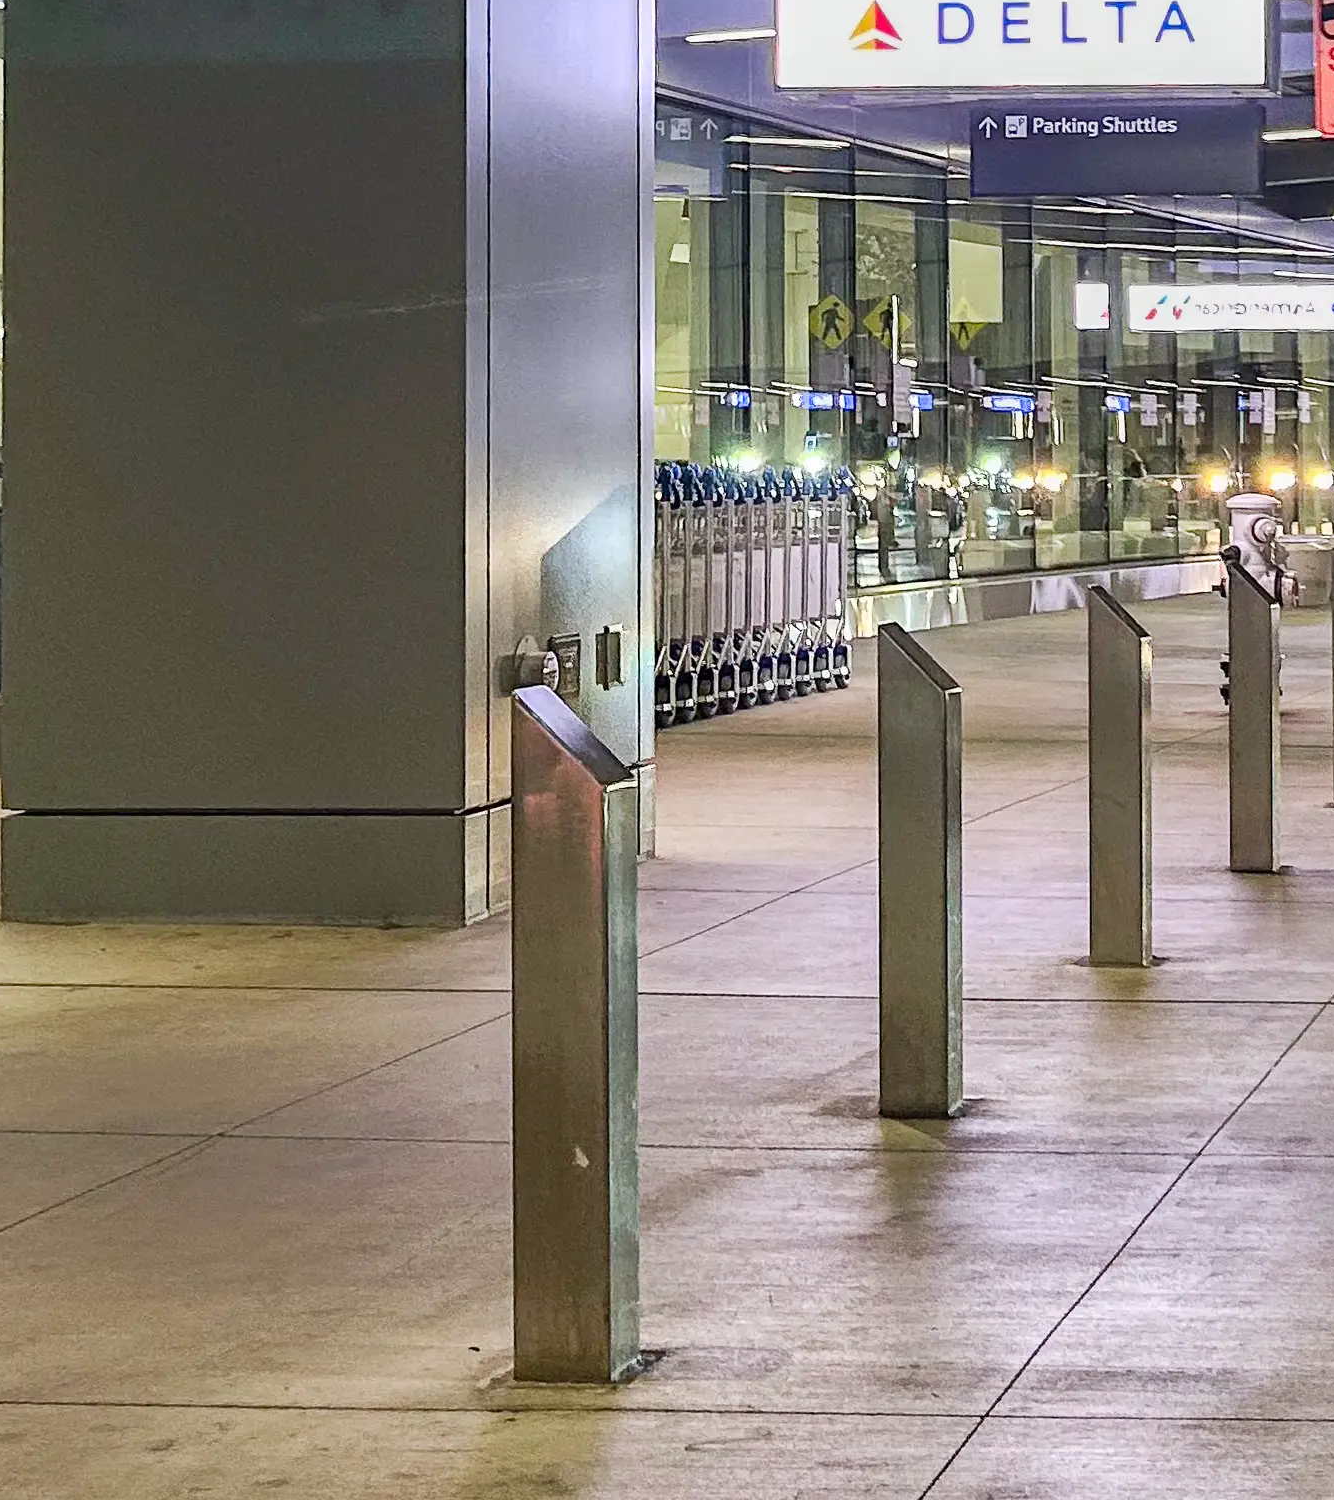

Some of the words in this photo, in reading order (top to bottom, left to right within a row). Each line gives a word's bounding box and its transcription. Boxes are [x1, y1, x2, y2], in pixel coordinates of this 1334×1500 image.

[937, 0, 1196, 44] DELTA
[1032, 116, 1099, 137] Parking
[1102, 115, 1178, 134] Shuttles
